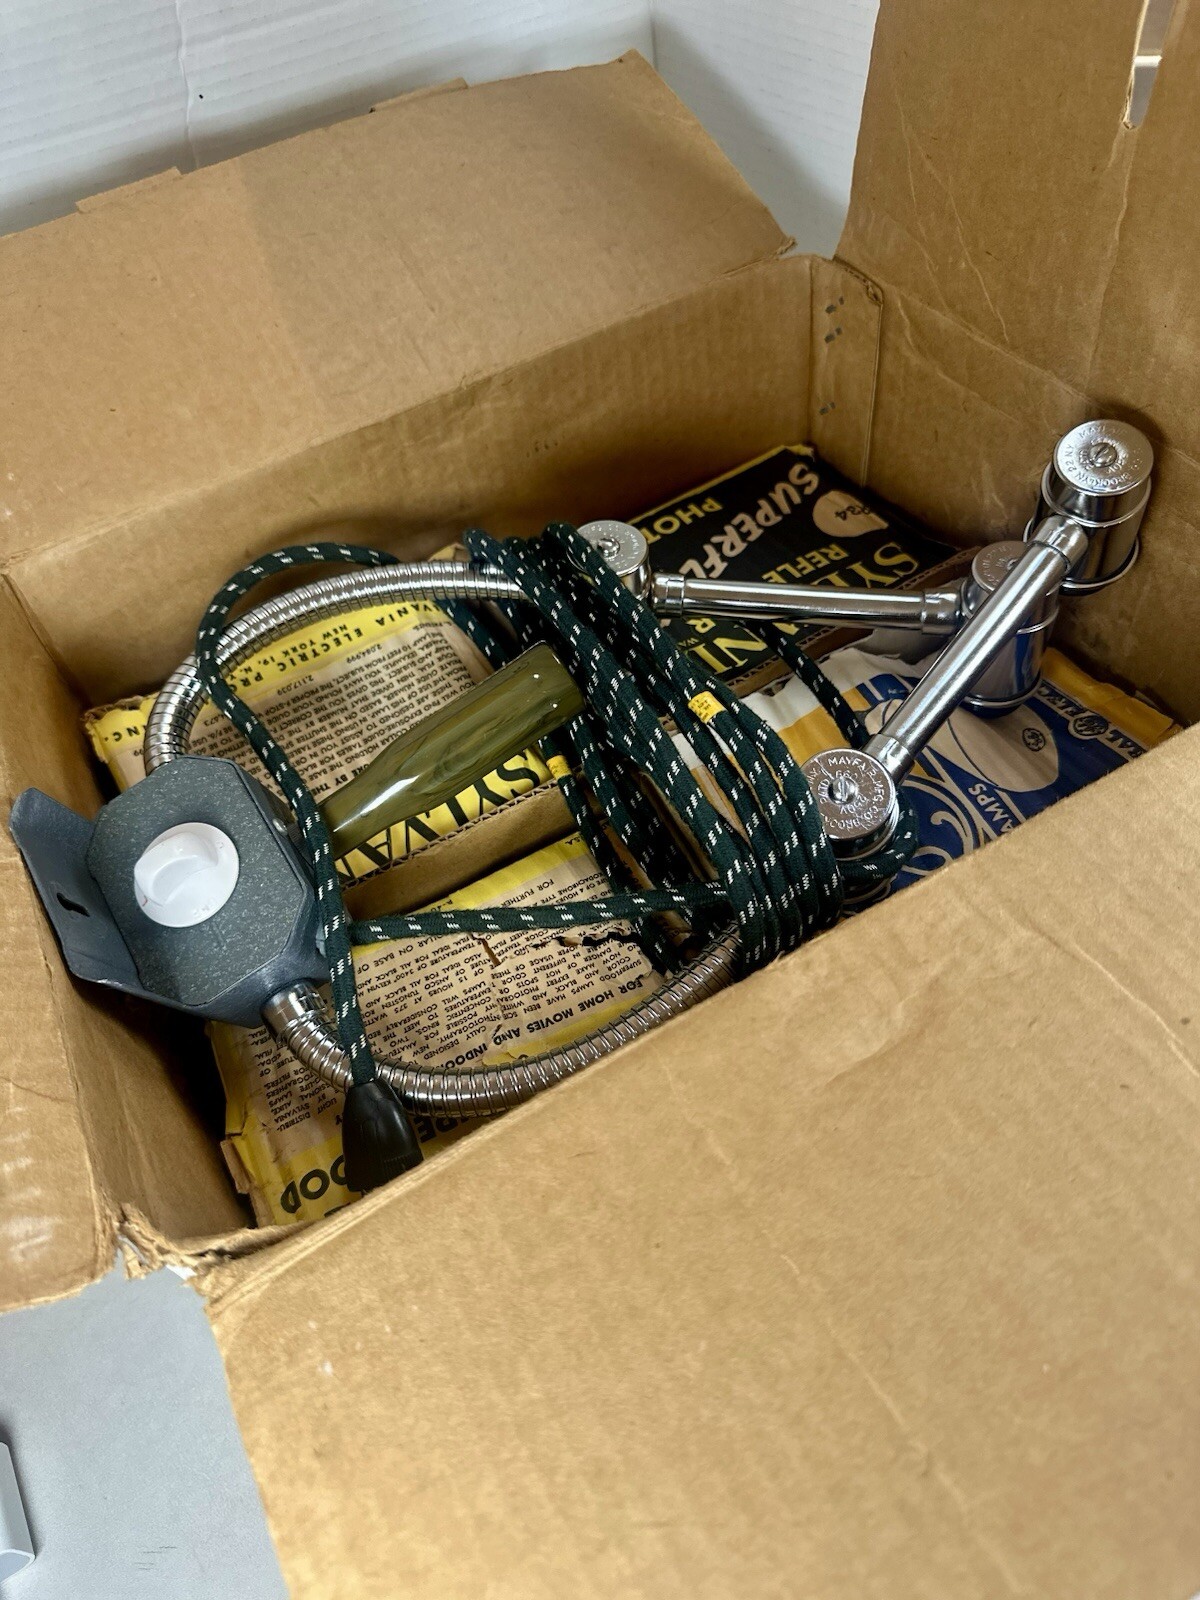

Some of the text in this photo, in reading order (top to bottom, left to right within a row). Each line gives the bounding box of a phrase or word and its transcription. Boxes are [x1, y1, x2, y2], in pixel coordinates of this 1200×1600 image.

[282, 624, 347, 658] NEW YORK
[401, 643, 411, 652] 10
[276, 627, 363, 672] ELECTRIC
[364, 655, 386, 670] FROM
[364, 668, 381, 680] YOU
[415, 668, 438, 685] GUIDE
[319, 681, 333, 691] THE
[343, 676, 363, 690] HAVE
[368, 676, 384, 688] THIS
[418, 682, 432, 694] USE
[315, 687, 342, 704] FOUND
[370, 681, 394, 698] DIVIDE
[406, 690, 417, 700] OF
[328, 695, 346, 709] YOU
[390, 696, 406, 709] THIS
[415, 693, 429, 705] ARE
[422, 699, 440, 712] FIND
[292, 699, 313, 714] YOUR
[313, 704, 327, 714] THE
[317, 704, 348, 723] NUMBER
[378, 701, 414, 725] DESIGNED
[266, 710, 291, 725] GUIDE
[278, 710, 312, 731] CORRECT
[344, 711, 357, 721] ON
[304, 720, 315, 729] BY
[328, 718, 342, 729] THE
[334, 720, 359, 737] USING
[365, 722, 377, 732] TO
[287, 726, 302, 737] THE
[295, 725, 327, 744] SHUTTER
[339, 728, 363, 745] ASSIST
[311, 732, 333, 748] THESE
[320, 741, 338, 755] YOU
[336, 740, 361, 758] TABLES
[319, 754, 335, 766] FOR
[328, 760, 342, 771] THE
[308, 768, 327, 781] BASE
[333, 773, 348, 786] BY
[539, 892, 556, 904] TYPE
[428, 941, 475, 966] TEMPERATURE
[463, 951, 482, 964] ALSO
[528, 952, 553, 967] USAGE
[583, 946, 612, 963] DANGER
[601, 950, 621, 965] NOW
[415, 962, 428, 971] OF
[441, 961, 460, 974] IDEAL
[514, 963, 525, 972] OF
[532, 956, 566, 975] DIFFERENT
[566, 960, 577, 970] OF
[574, 961, 595, 974] MAKE
[605, 954, 631, 972] COLOR
[424, 970, 439, 982] FOR
[454, 967, 465, 976] OF
[472, 967, 484, 976] OF
[544, 967, 561, 979] HOT
[583, 968, 599, 979] AND
[598, 958, 642, 983] SUPERFLOOD
[409, 978, 422, 988] ALL
[423, 974, 450, 990] ANSCO
[500, 970, 526, 986] COLOR
[515, 976, 538, 988] SPOTS
[545, 972, 569, 988] EXPERT
[554, 978, 577, 992] BLACK
[366, 978, 391, 994] KELVIN
[384, 985, 406, 1000] BLACK
[427, 981, 453, 997] HOURS
[462, 980, 486, 995] LAMPS
[570, 980, 594, 995] LAMPS
[364, 996, 381, 1009] AND
[380, 988, 418, 1010] TUNGSTEN
[412, 995, 423, 1004] AT
[440, 993, 458, 1005] WILL
[531, 990, 547, 1001] AND
[545, 992, 565, 1005] HAVE
[576, 988, 614, 1012] HOME
[393, 1002, 408, 1014] 375
[445, 995, 492, 1021] CONCENTRIC
[522, 1002, 541, 1013] BEEN
[384, 1002, 438, 1032] CONSIDERABLY
[426, 1011, 438, 1021] TO
[444, 1010, 478, 1030] POSSIBLE
[525, 1007, 574, 1034] MOVIES
[402, 1019, 421, 1033] MEET
[381, 1030, 396, 1042] THE
[388, 1034, 408, 1048] TWO
[423, 1029, 439, 1041] FOR
[492, 1026, 522, 1047] AND
[410, 1042, 430, 1057] NEW
[422, 1038, 459, 1060] DESIGNED
[273, 1101, 310, 1124] SYLVANIA
